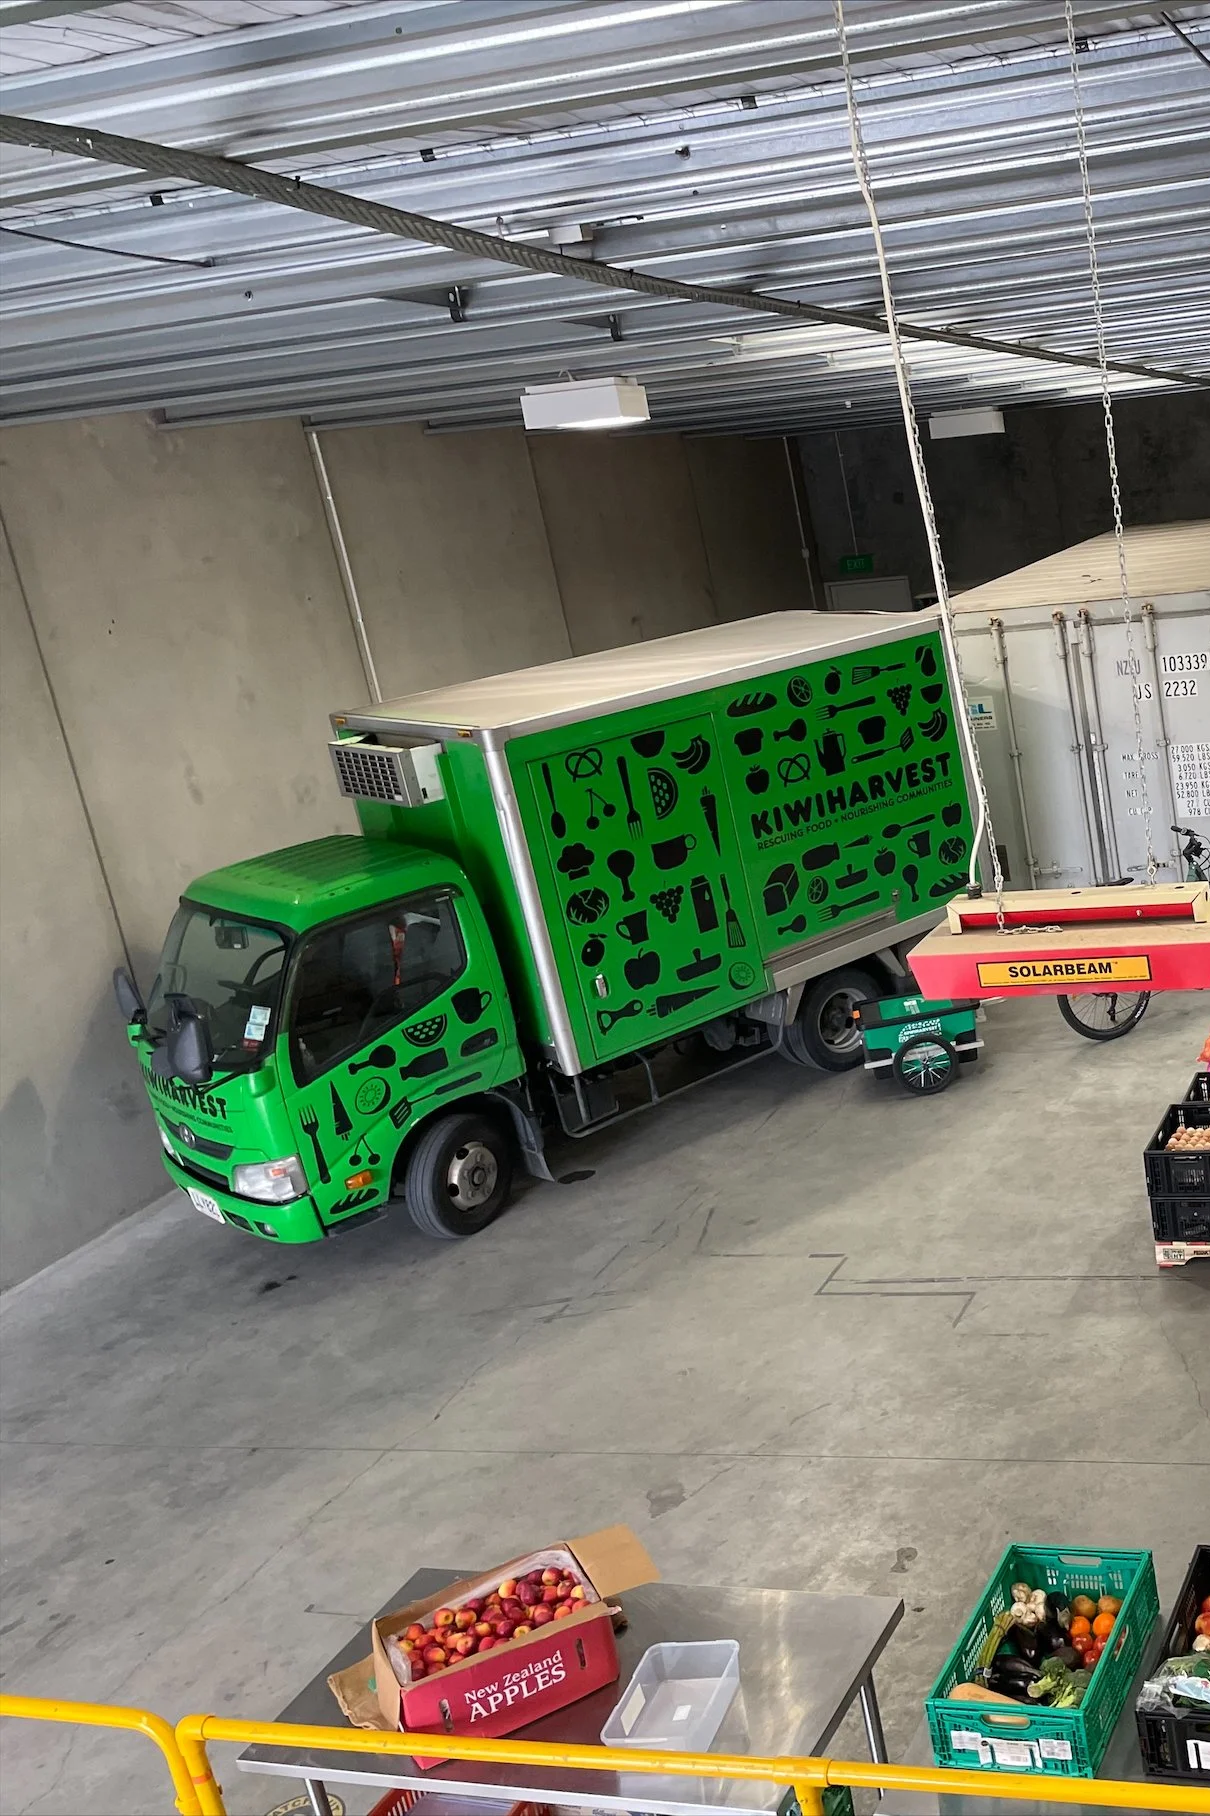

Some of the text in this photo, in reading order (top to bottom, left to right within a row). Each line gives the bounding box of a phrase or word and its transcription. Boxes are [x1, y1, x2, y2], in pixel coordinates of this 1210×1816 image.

[846, 559, 865, 570] EXIT
[1162, 653, 1208, 673] 103339
[1164, 680, 1198, 698] 2232
[751, 752, 951, 840] KIWIHARVEST
[1126, 790, 1138, 798] NET
[757, 780, 954, 851] RESCUING FOOD NOURISHING COMMUNITIES
[1008, 962, 1112, 978] SOLARBEAM
[464, 1650, 563, 1704] New Zealand
[470, 1663, 567, 1723] APPLES
